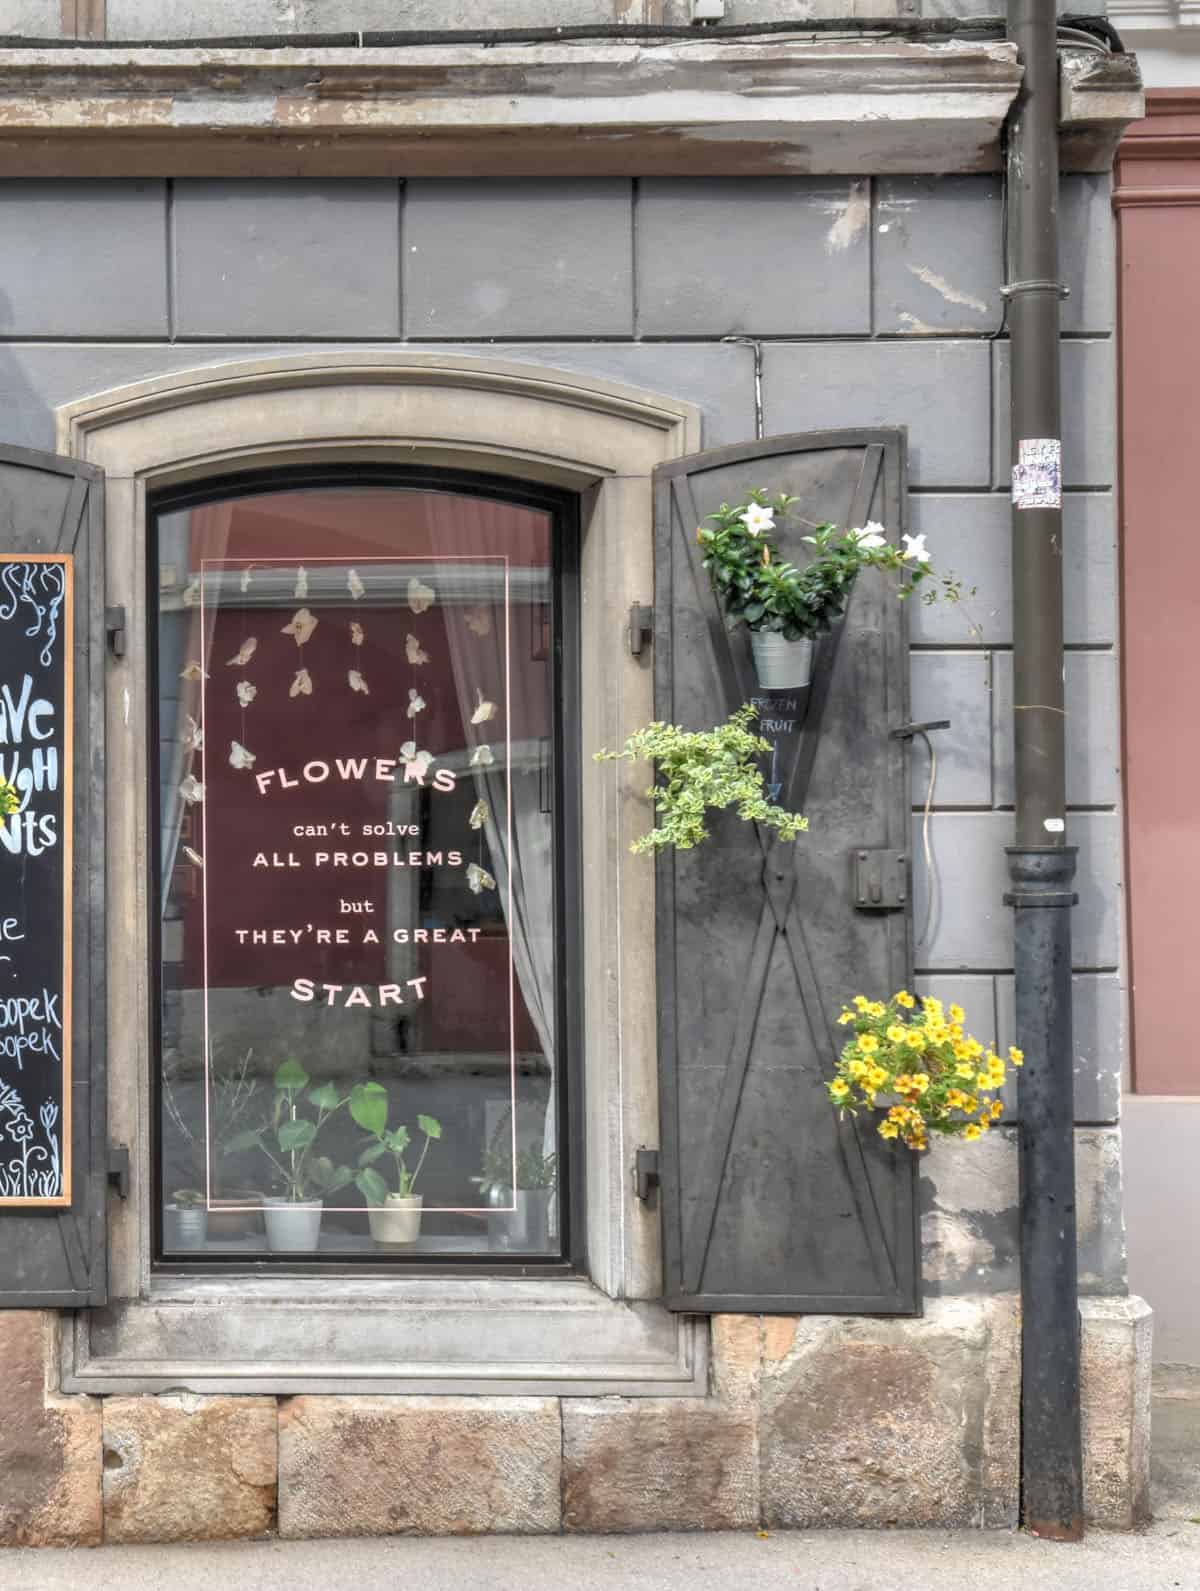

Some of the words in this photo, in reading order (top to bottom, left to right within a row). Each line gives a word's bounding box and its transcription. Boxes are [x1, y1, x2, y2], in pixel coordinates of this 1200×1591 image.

[760, 719, 795, 734] FRUIT
[255, 758, 457, 795] FLOWERS
[293, 823, 351, 836] can't
[362, 822, 420, 836] solve
[253, 853, 300, 867] ALL
[315, 851, 463, 867] PROBLEMS
[340, 900, 374, 913] but
[236, 924, 349, 944] THEY'RE
[363, 931, 379, 943] A
[393, 928, 481, 943] GREAT
[290, 977, 427, 1008] START
